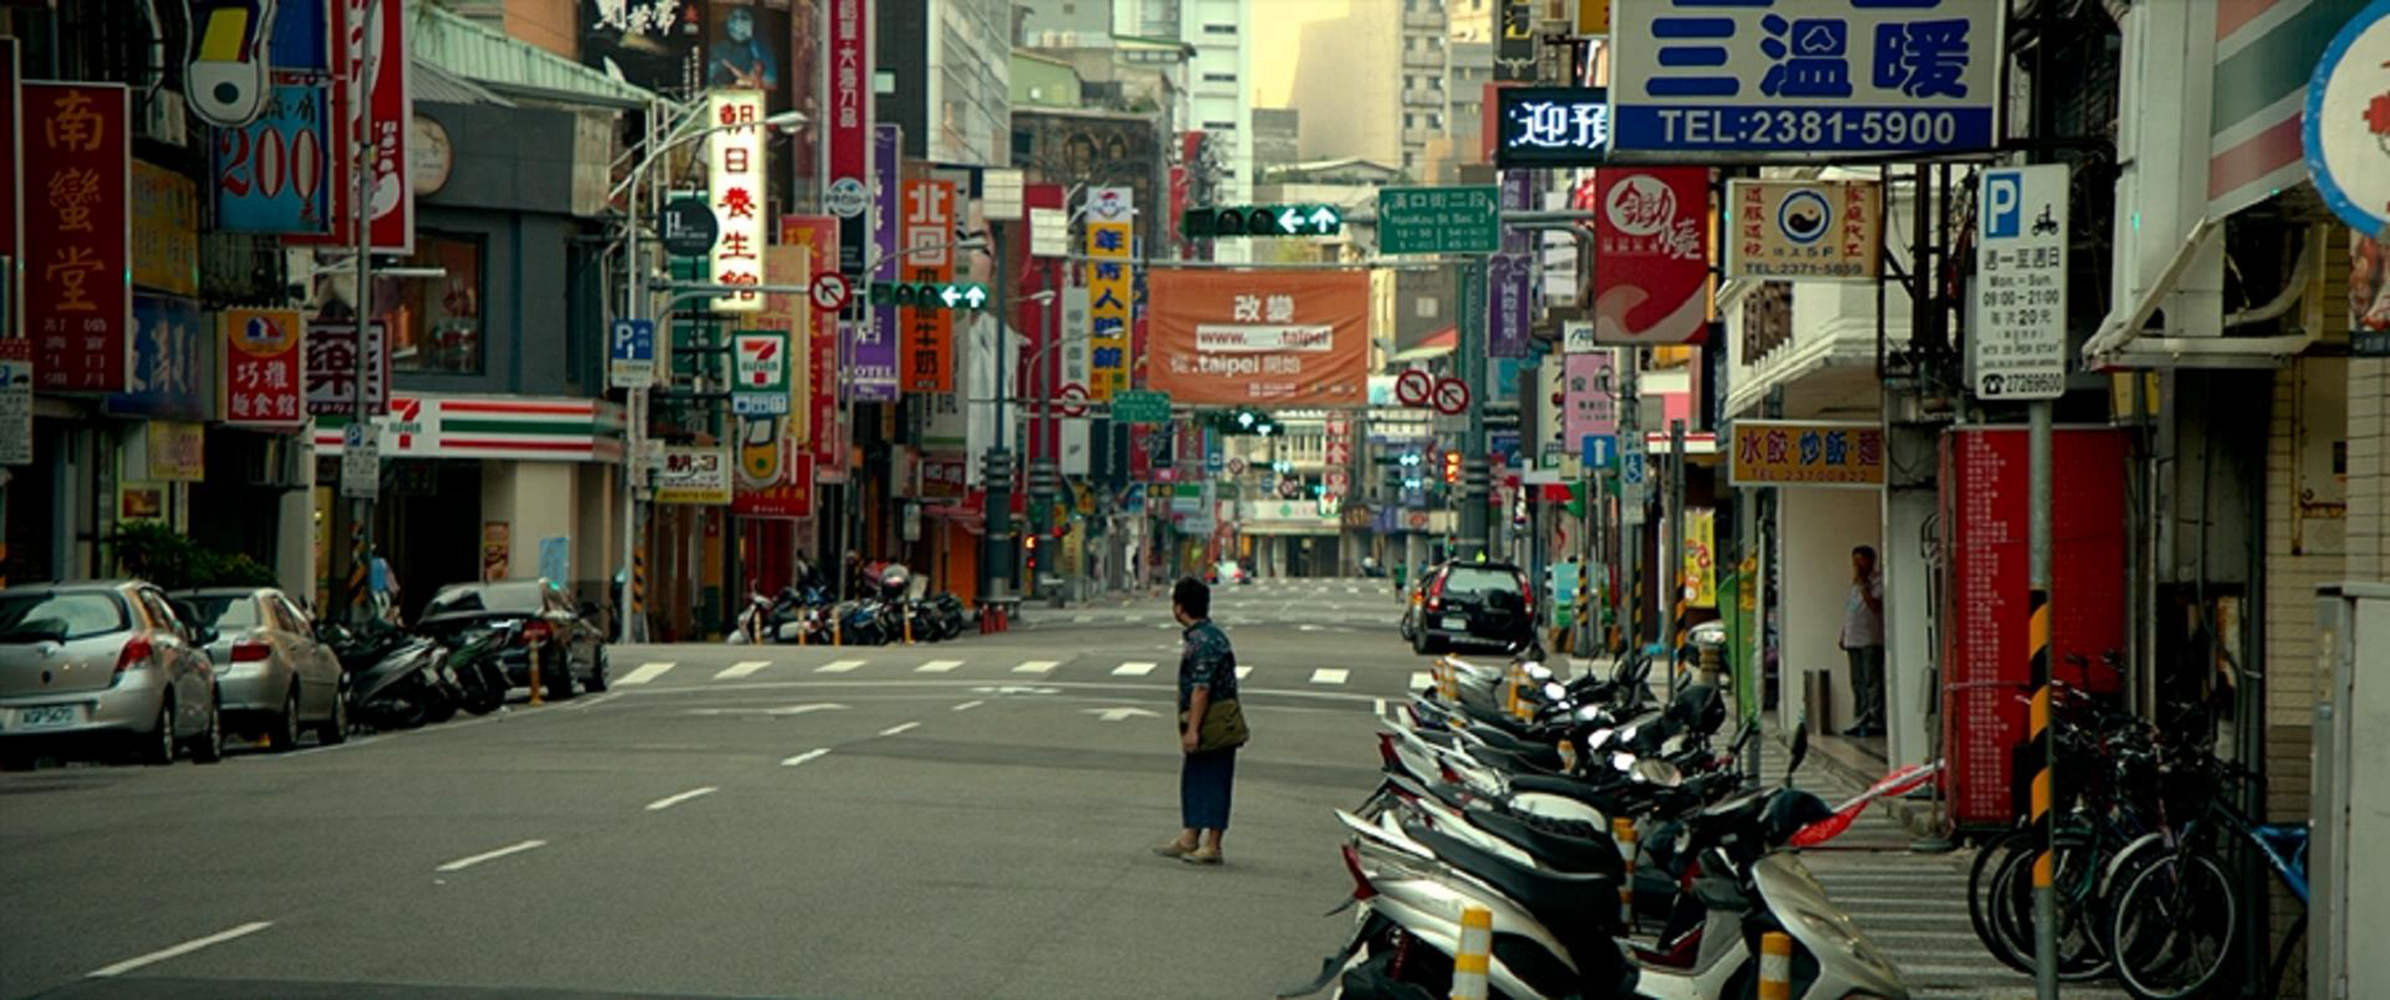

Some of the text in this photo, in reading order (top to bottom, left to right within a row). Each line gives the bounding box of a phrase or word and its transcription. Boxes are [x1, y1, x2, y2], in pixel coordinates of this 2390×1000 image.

[1645, 13, 1970, 98] 三溫暖
[44, 89, 105, 311] 南蠻堂
[220, 126, 323, 197] 200
[717, 103, 758, 301] 朝日養生館
[1233, 294, 1296, 323] 改變
